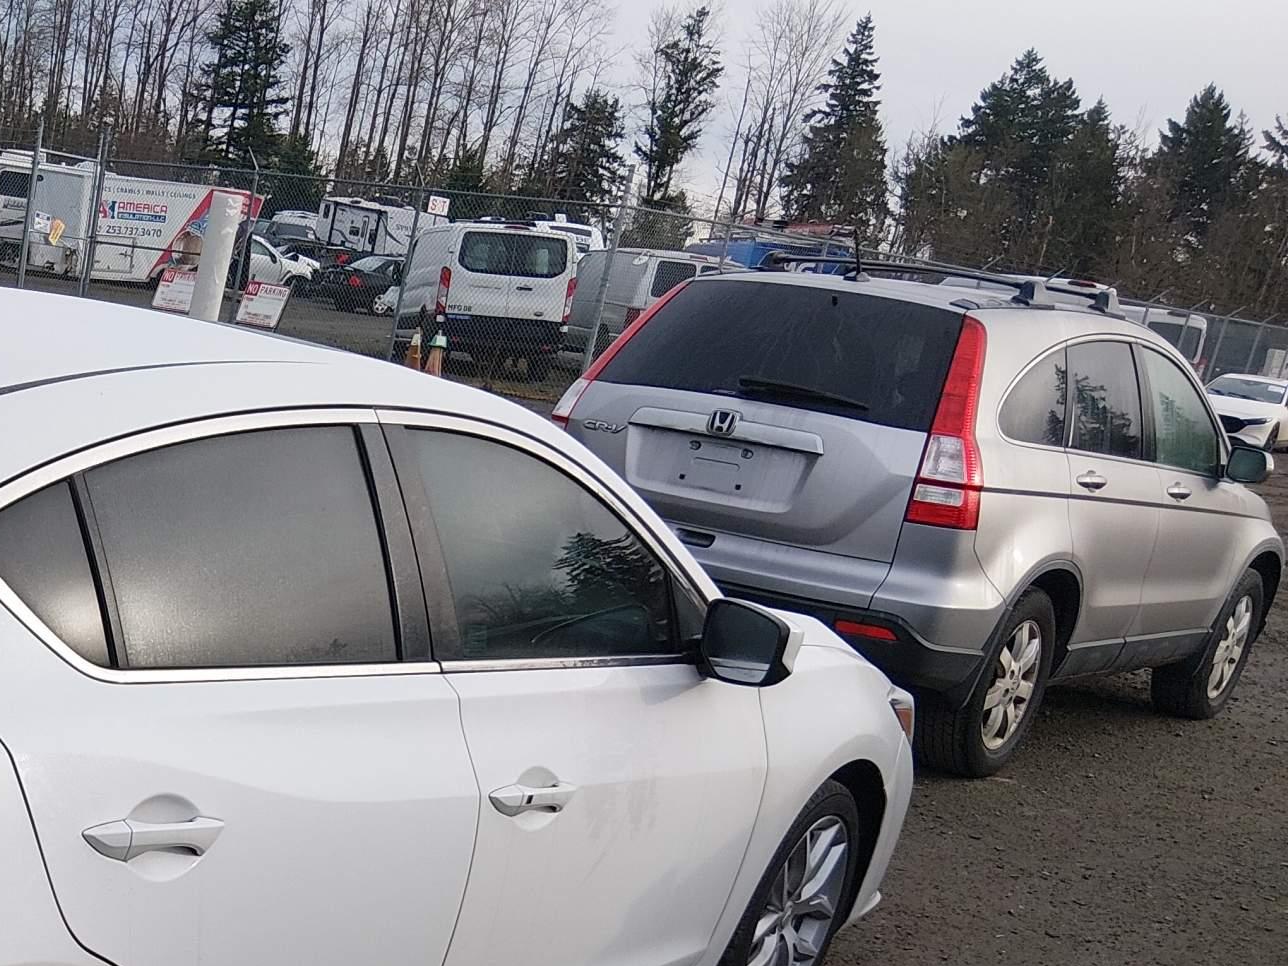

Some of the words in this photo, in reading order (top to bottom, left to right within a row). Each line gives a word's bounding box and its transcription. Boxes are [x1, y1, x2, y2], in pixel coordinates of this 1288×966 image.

[117, 201, 168, 214] AMERICA
[430, 198, 438, 211] S
[440, 199, 447, 213] T
[106, 225, 162, 238] 253.737.3470
[163, 271, 175, 281] NO
[247, 283, 259, 295] NO
[259, 286, 288, 298] PARKING
[583, 418, 628, 434] CR-V
